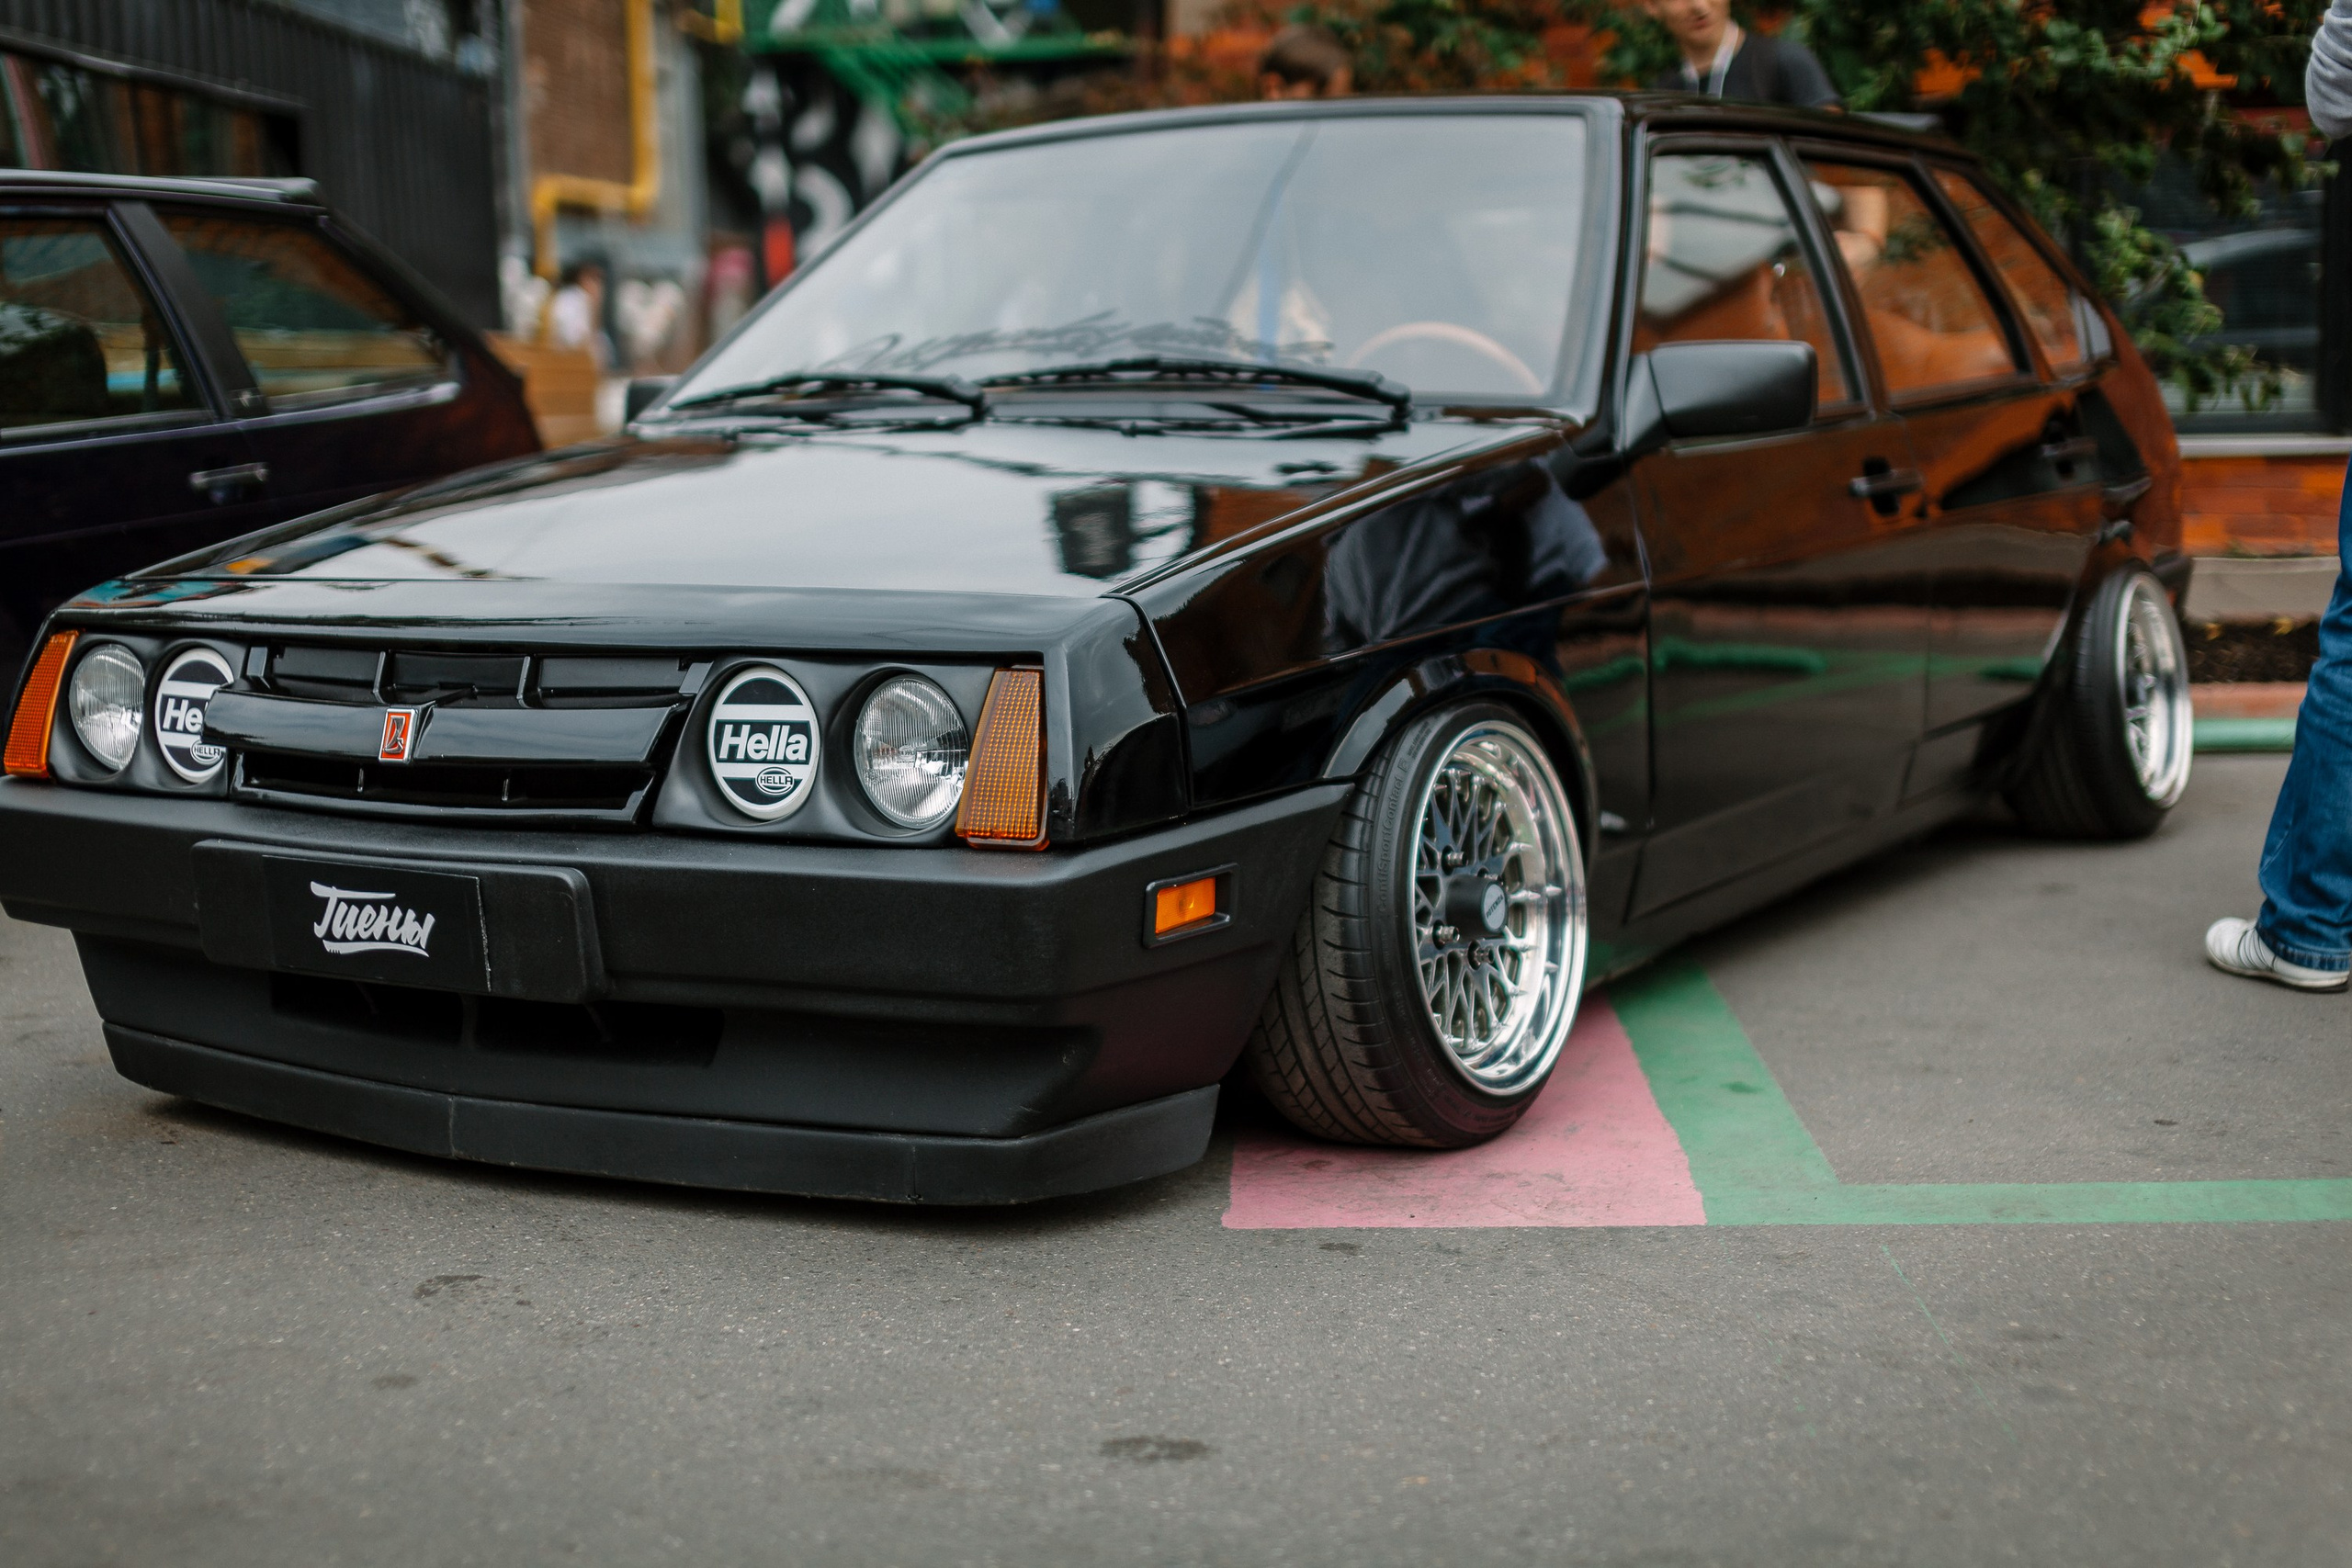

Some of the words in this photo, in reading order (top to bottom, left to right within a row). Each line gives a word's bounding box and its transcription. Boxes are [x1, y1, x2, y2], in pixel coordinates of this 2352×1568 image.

[718, 724, 808, 762] Hella
[193, 745, 221, 757] HELLA
[760, 775, 793, 785] HELLA
